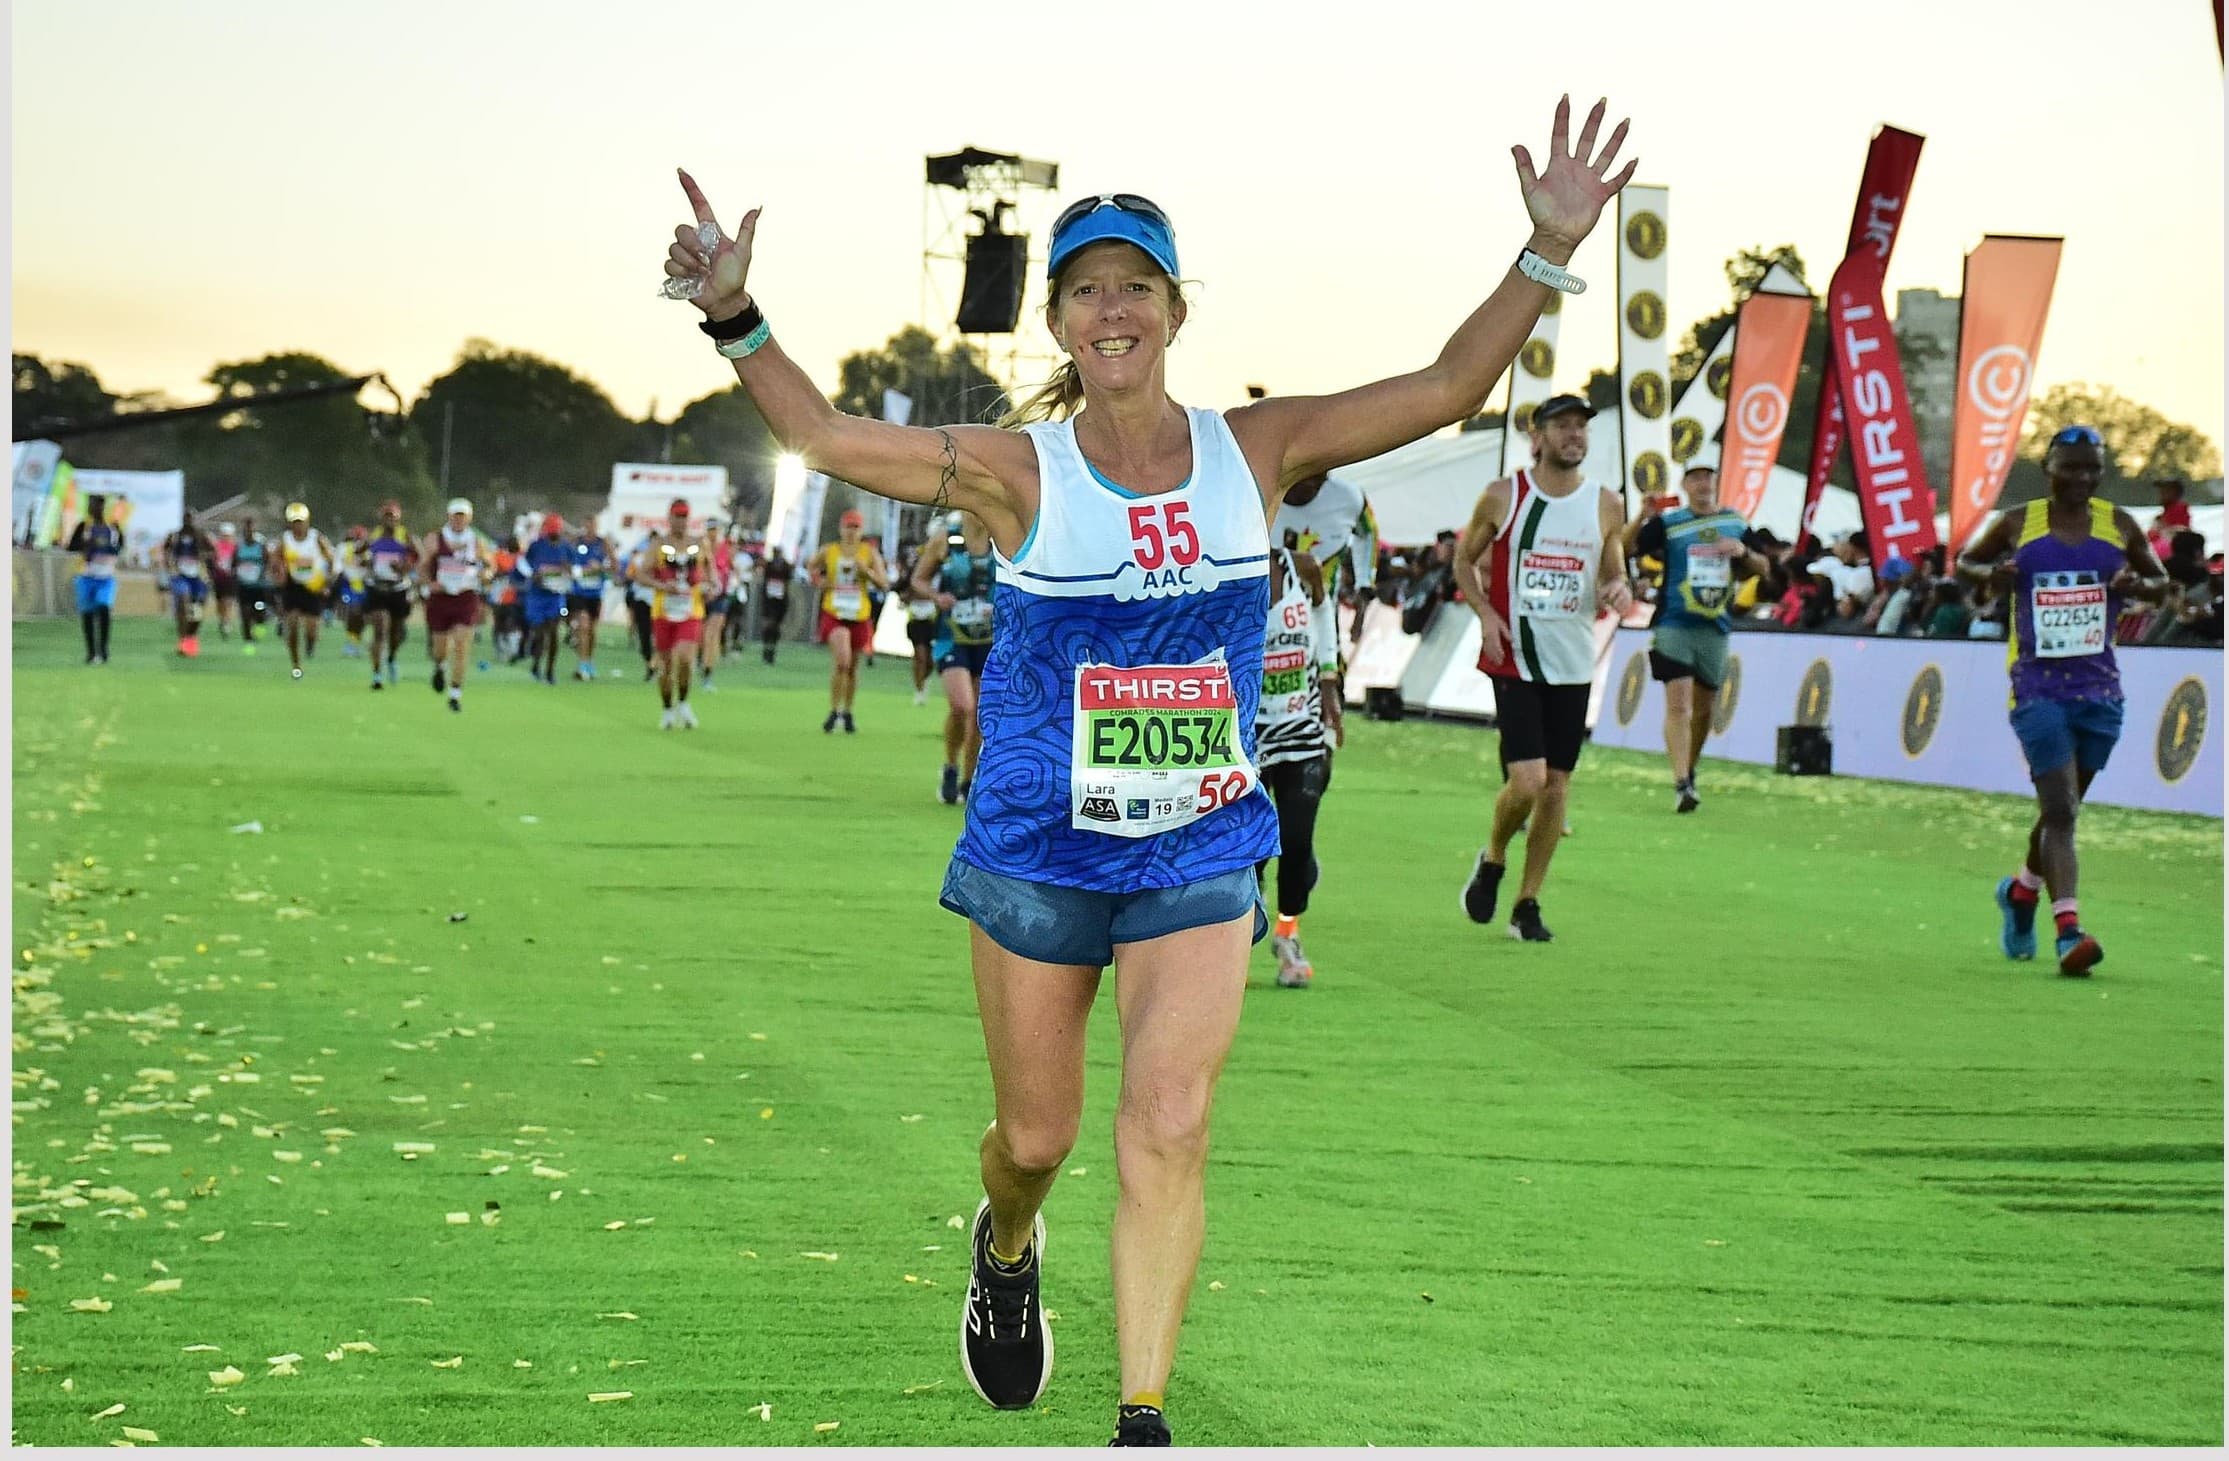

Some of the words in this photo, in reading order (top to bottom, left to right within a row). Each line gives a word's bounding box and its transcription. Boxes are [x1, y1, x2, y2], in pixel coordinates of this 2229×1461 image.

[1128, 501, 1200, 571] 55
[1143, 566, 1193, 589] AAC
[1284, 603, 1308, 629] 65
[1263, 671, 1302, 695] 3613
[1157, 709, 1201, 717] MARATHON
[1092, 716, 1232, 766] E20534
[1087, 783, 1115, 794] Lara
[1196, 771, 1247, 814] 50
[1085, 799, 1116, 813] ASA
[1155, 803, 1172, 816] 19
